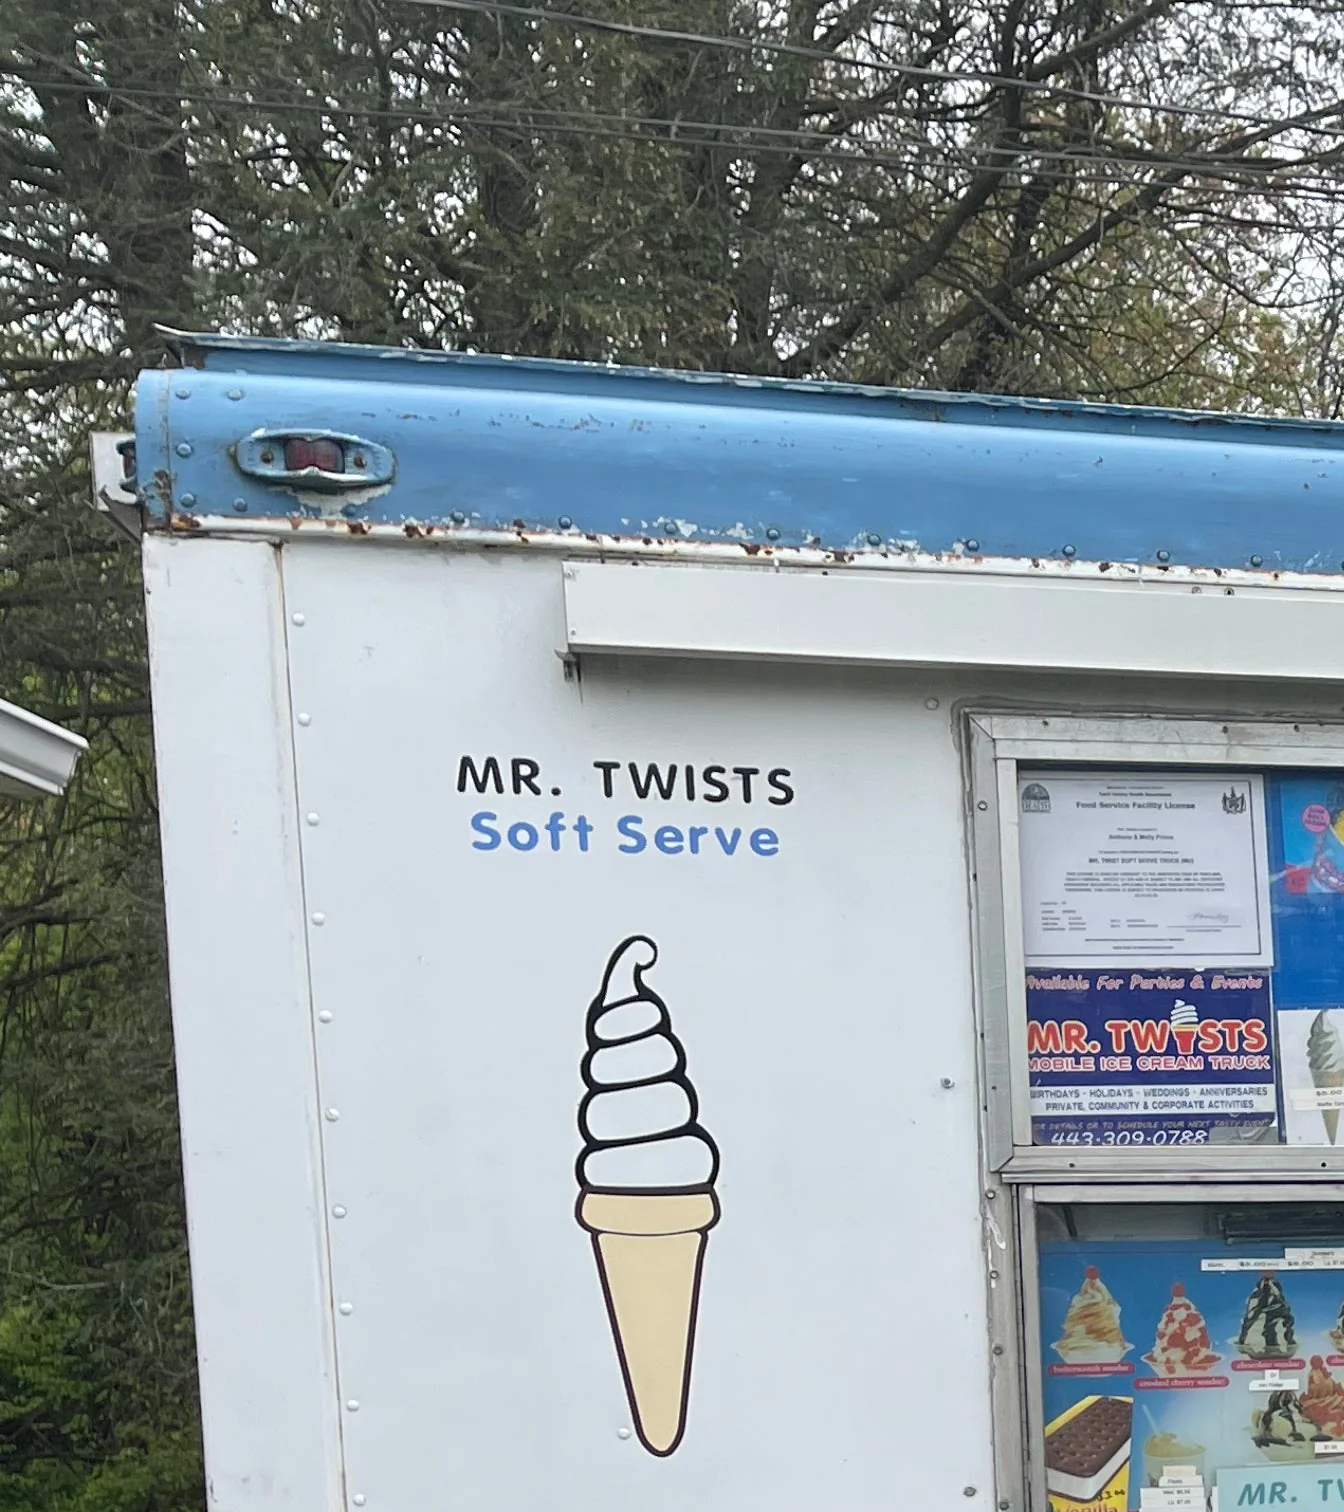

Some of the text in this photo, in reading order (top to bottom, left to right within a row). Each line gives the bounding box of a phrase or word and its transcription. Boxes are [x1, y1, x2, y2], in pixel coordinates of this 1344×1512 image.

[457, 756, 795, 806] MR. TWISTS
[1076, 801, 1196, 811] Food Service Facility License
[471, 811, 780, 857] Soft Serve
[1026, 974, 1090, 990] Available
[1096, 975, 1124, 990] For
[1129, 974, 1185, 991] Parties
[1210, 974, 1263, 990] Events
[1027, 1019, 1101, 1055] MR.
[1028, 1055, 1271, 1071] MOBILE ICE CREAM TRUCK
[1089, 1088, 1134, 1098] HOLIDAYS
[1143, 1088, 1190, 1098] WEDDINGS
[1199, 1086, 1268, 1097] ANNIVERSARIES
[1088, 1101, 1140, 1111] COMMUNITY
[1151, 1100, 1206, 1110] CORPORATE
[1207, 1099, 1254, 1109] ACTIVITIES
[1237, 1481, 1297, 1506] MR.
